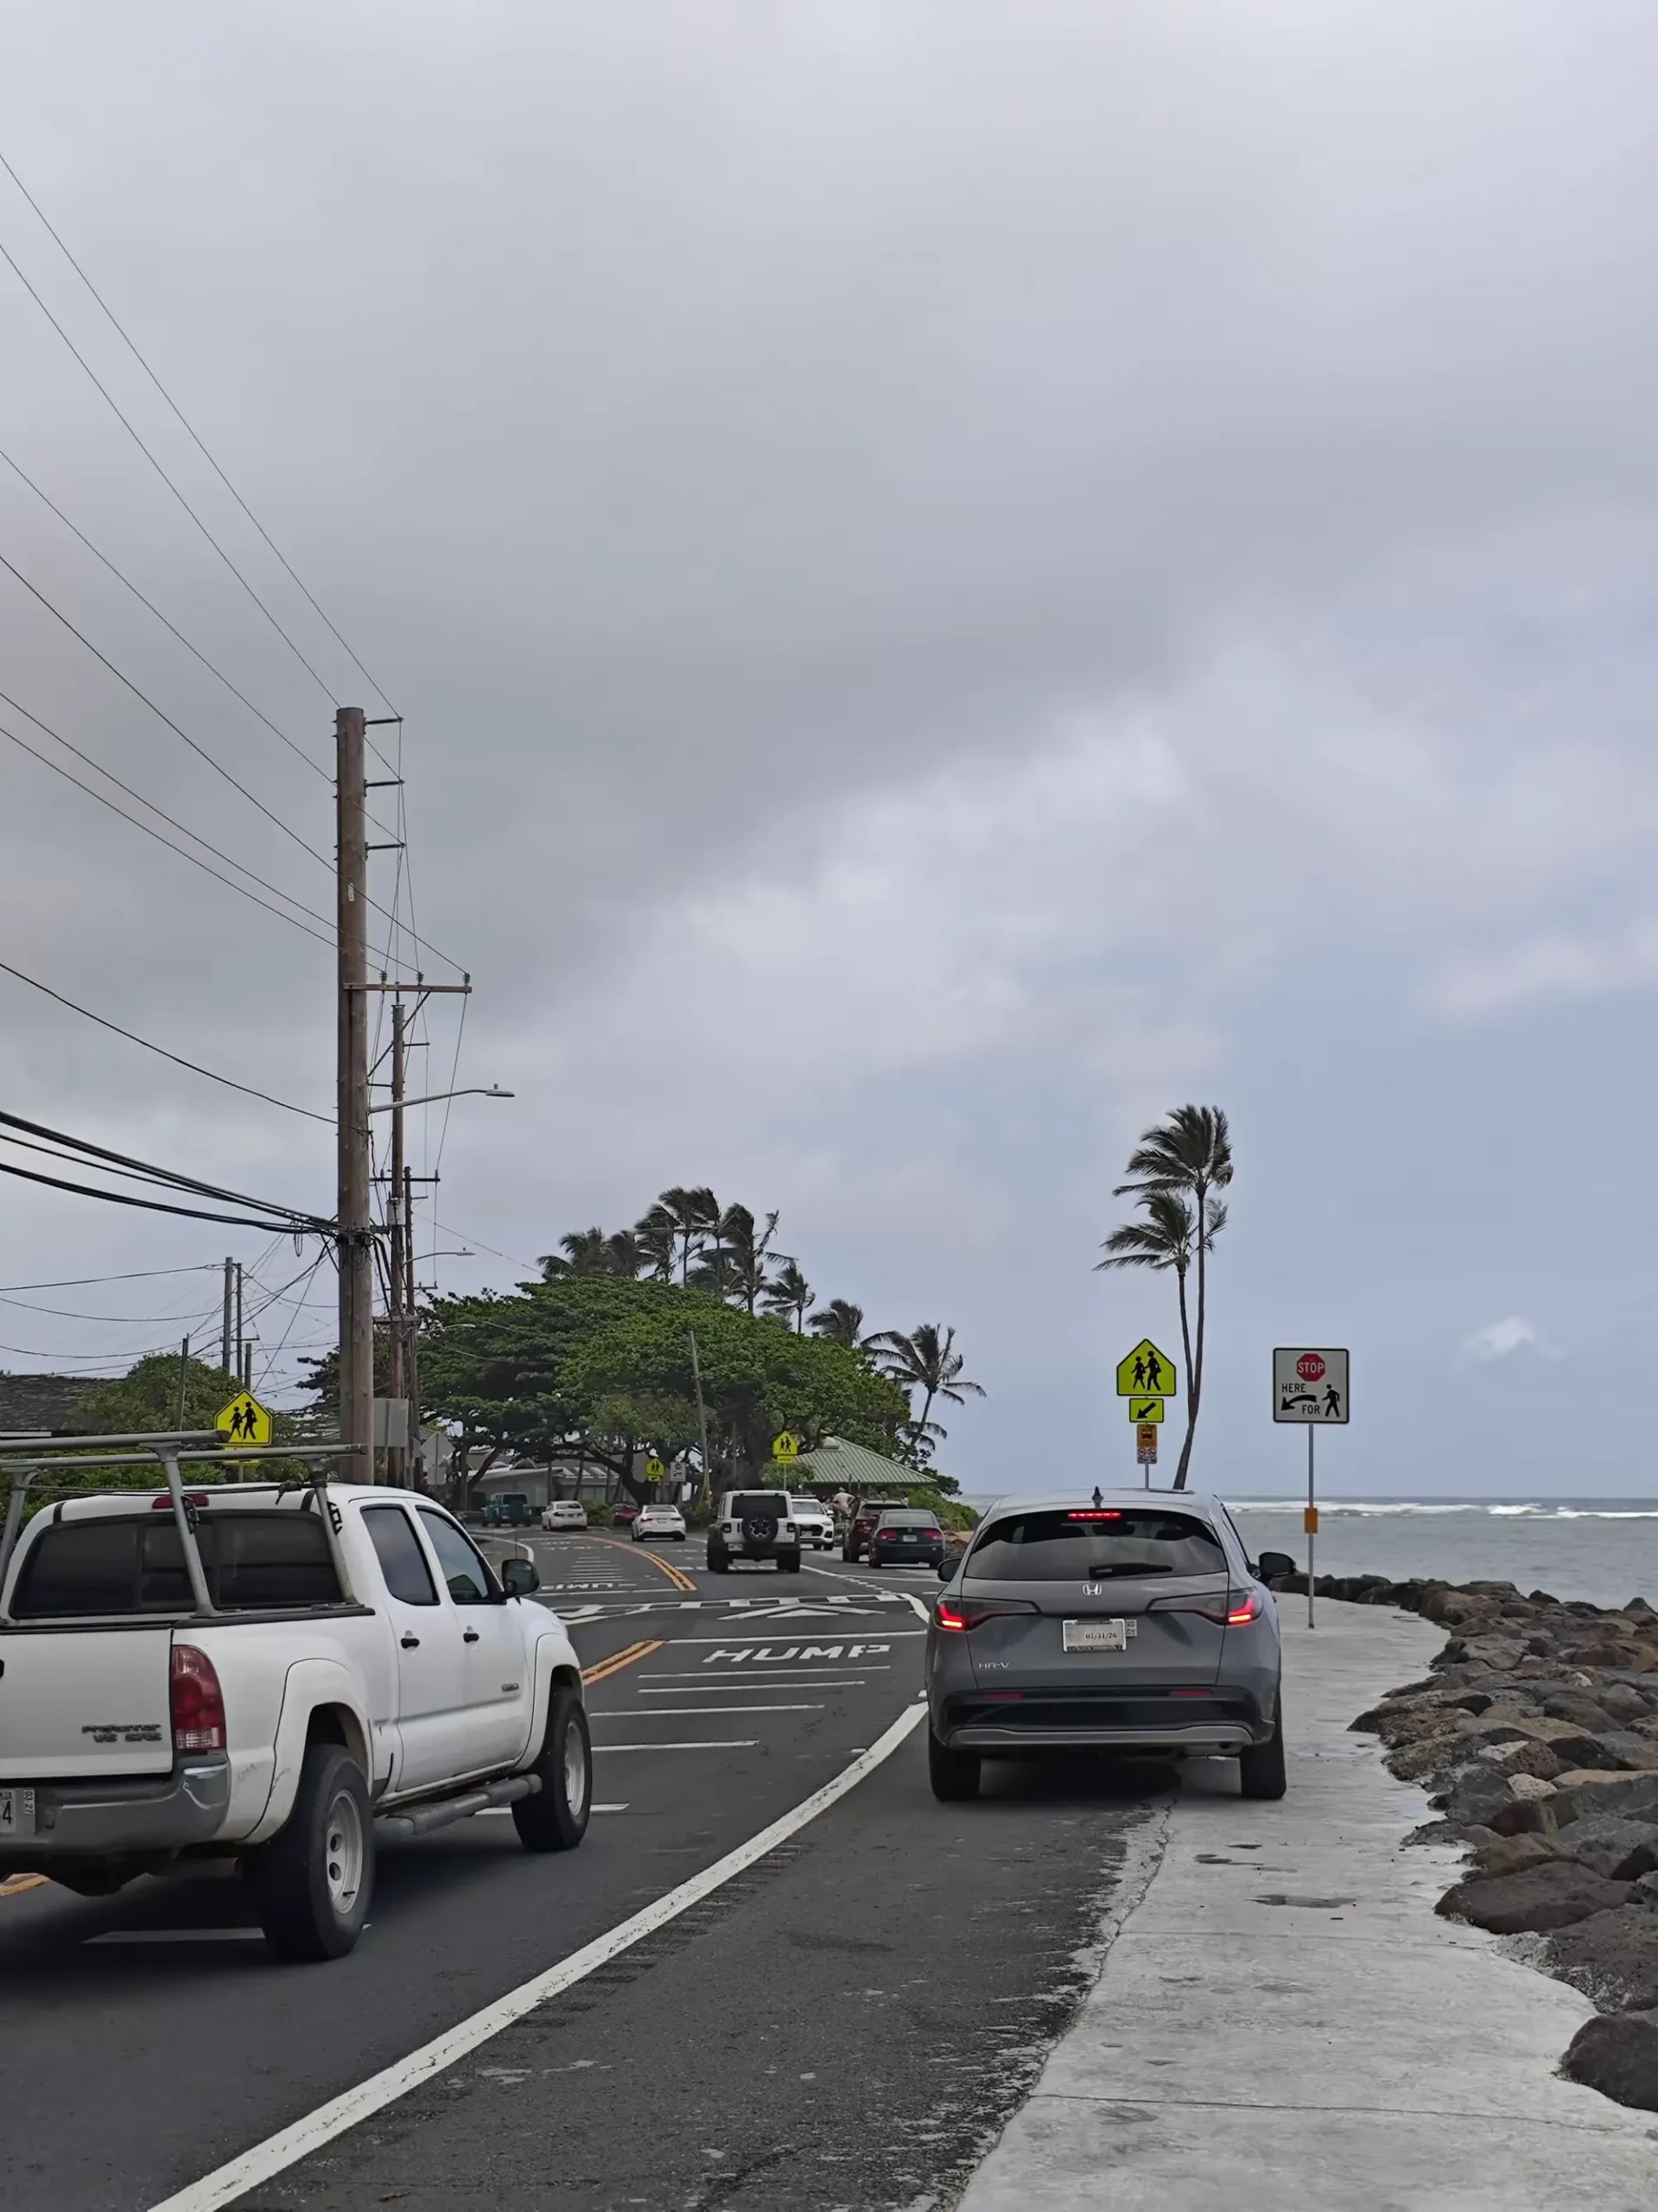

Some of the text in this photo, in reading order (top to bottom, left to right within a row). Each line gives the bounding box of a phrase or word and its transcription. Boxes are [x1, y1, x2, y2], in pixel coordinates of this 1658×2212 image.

[1298, 1362, 1324, 1374] STOP
[1281, 1383, 1306, 1393] HERE
[1301, 1404, 1320, 1414] FOR
[702, 1644, 891, 1663] HUMP
[0, 1800, 12, 1825] 4
